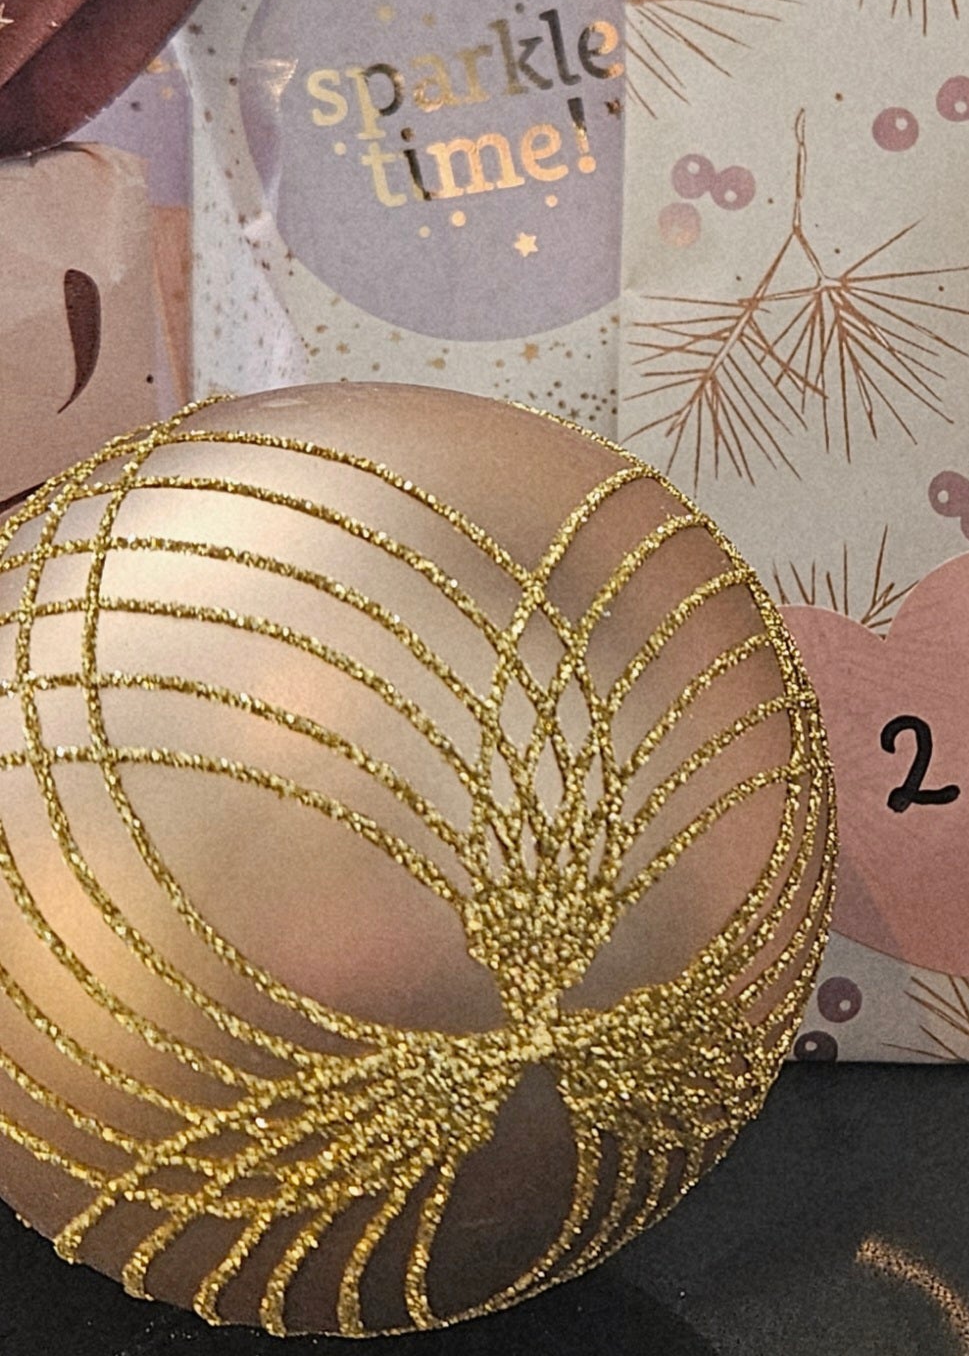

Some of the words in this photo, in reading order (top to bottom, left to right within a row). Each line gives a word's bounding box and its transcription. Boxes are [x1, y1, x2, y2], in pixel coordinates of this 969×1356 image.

[307, 8, 624, 139] sparkle
[361, 97, 596, 207] time!
[880, 715, 961, 813] 2
